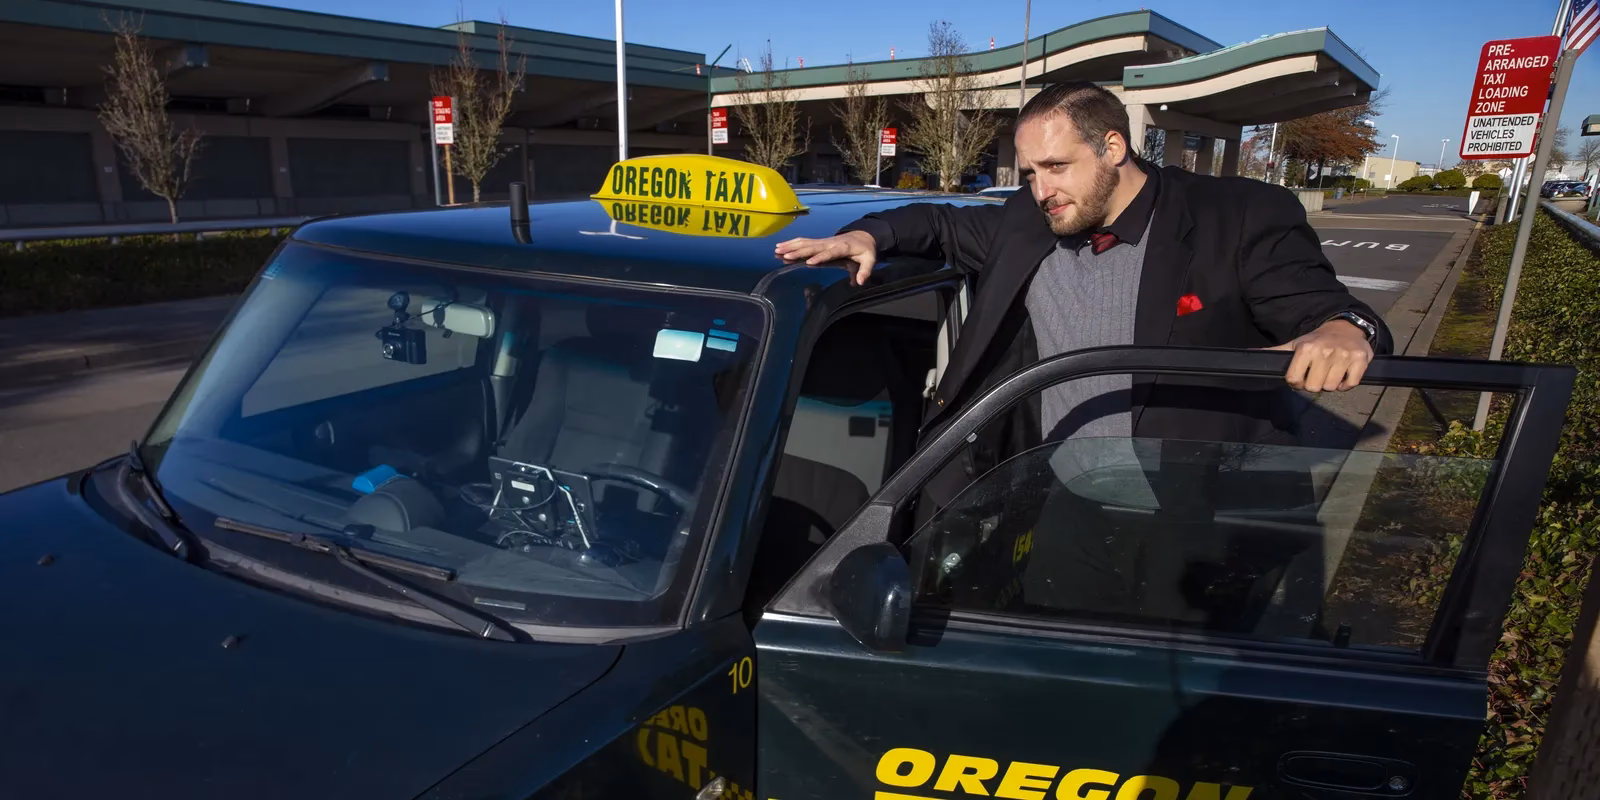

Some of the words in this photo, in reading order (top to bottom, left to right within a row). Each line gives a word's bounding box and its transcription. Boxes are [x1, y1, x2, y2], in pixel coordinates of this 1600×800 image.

[1488, 44, 1515, 57] PRE-
[1484, 55, 1549, 71] ARRANGED
[1482, 73, 1506, 85] TAXI
[1478, 86, 1529, 100] LOADING
[1475, 101, 1506, 114] ZONE
[1473, 116, 1534, 128] UNATTENDED
[1470, 129, 1515, 140] VEHICLES
[1467, 141, 1522, 153] PROHIBITED
[612, 165, 691, 200] OREGON
[705, 170, 755, 204] TAXI
[1320, 239, 1411, 251] BUM
[728, 657, 752, 694] 10
